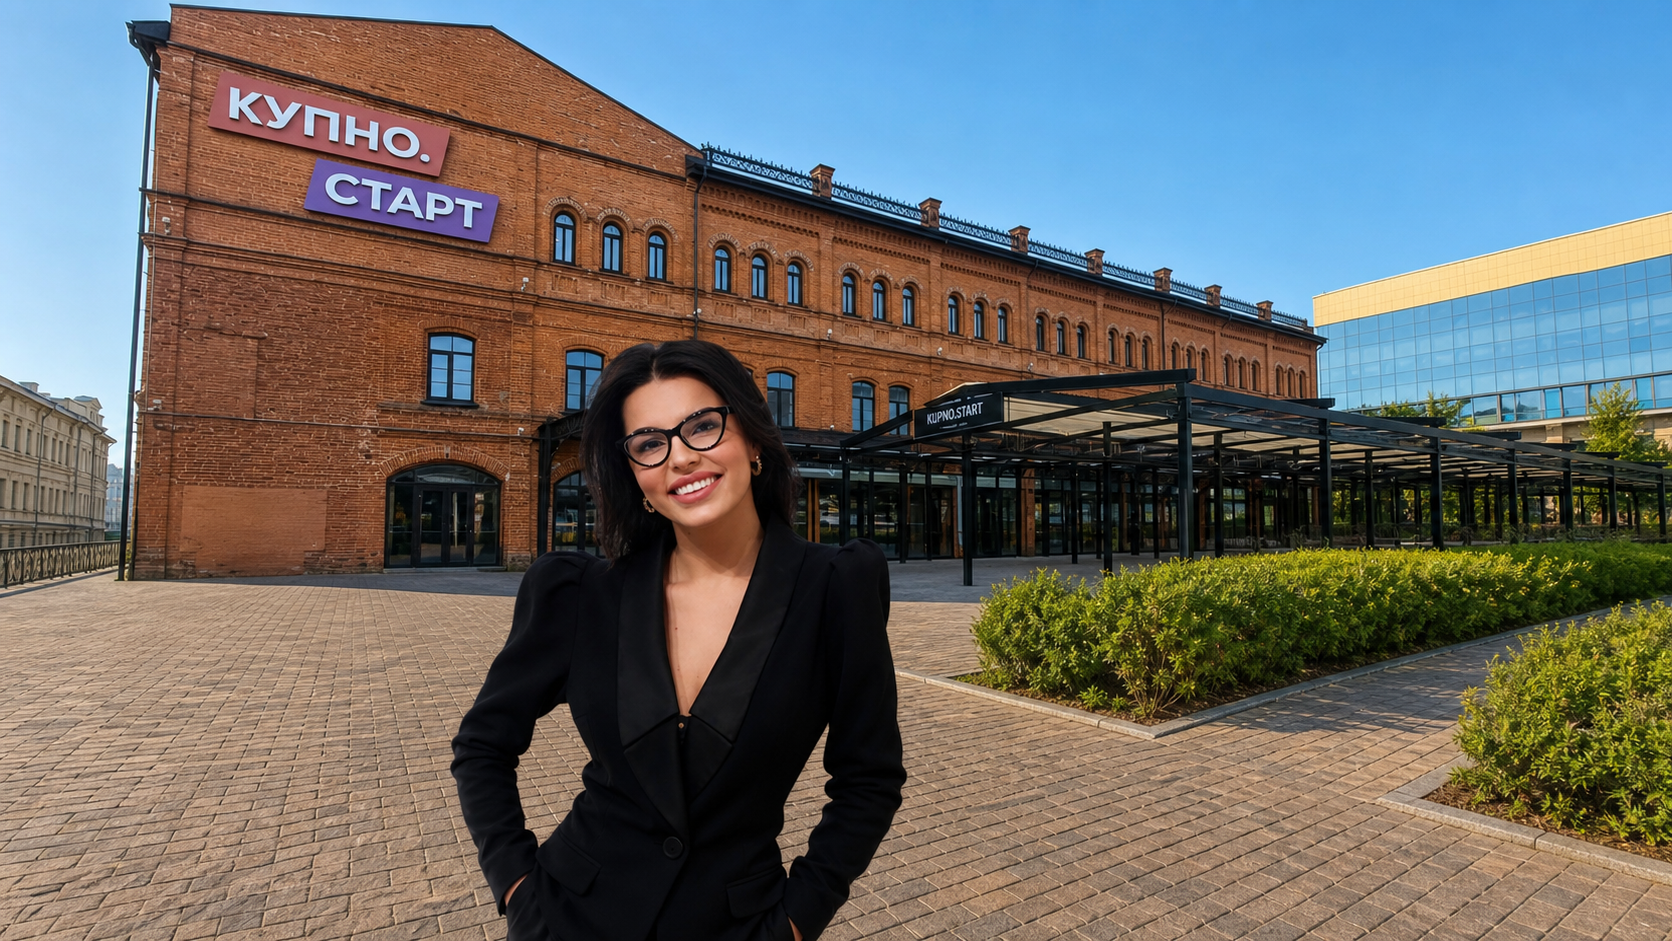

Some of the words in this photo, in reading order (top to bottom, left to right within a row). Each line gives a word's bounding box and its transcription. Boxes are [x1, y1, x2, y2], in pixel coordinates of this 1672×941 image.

[229, 86, 431, 163] КУПНО.
[325, 173, 483, 229] СТАРТ
[926, 402, 984, 425] KUPNO.START
